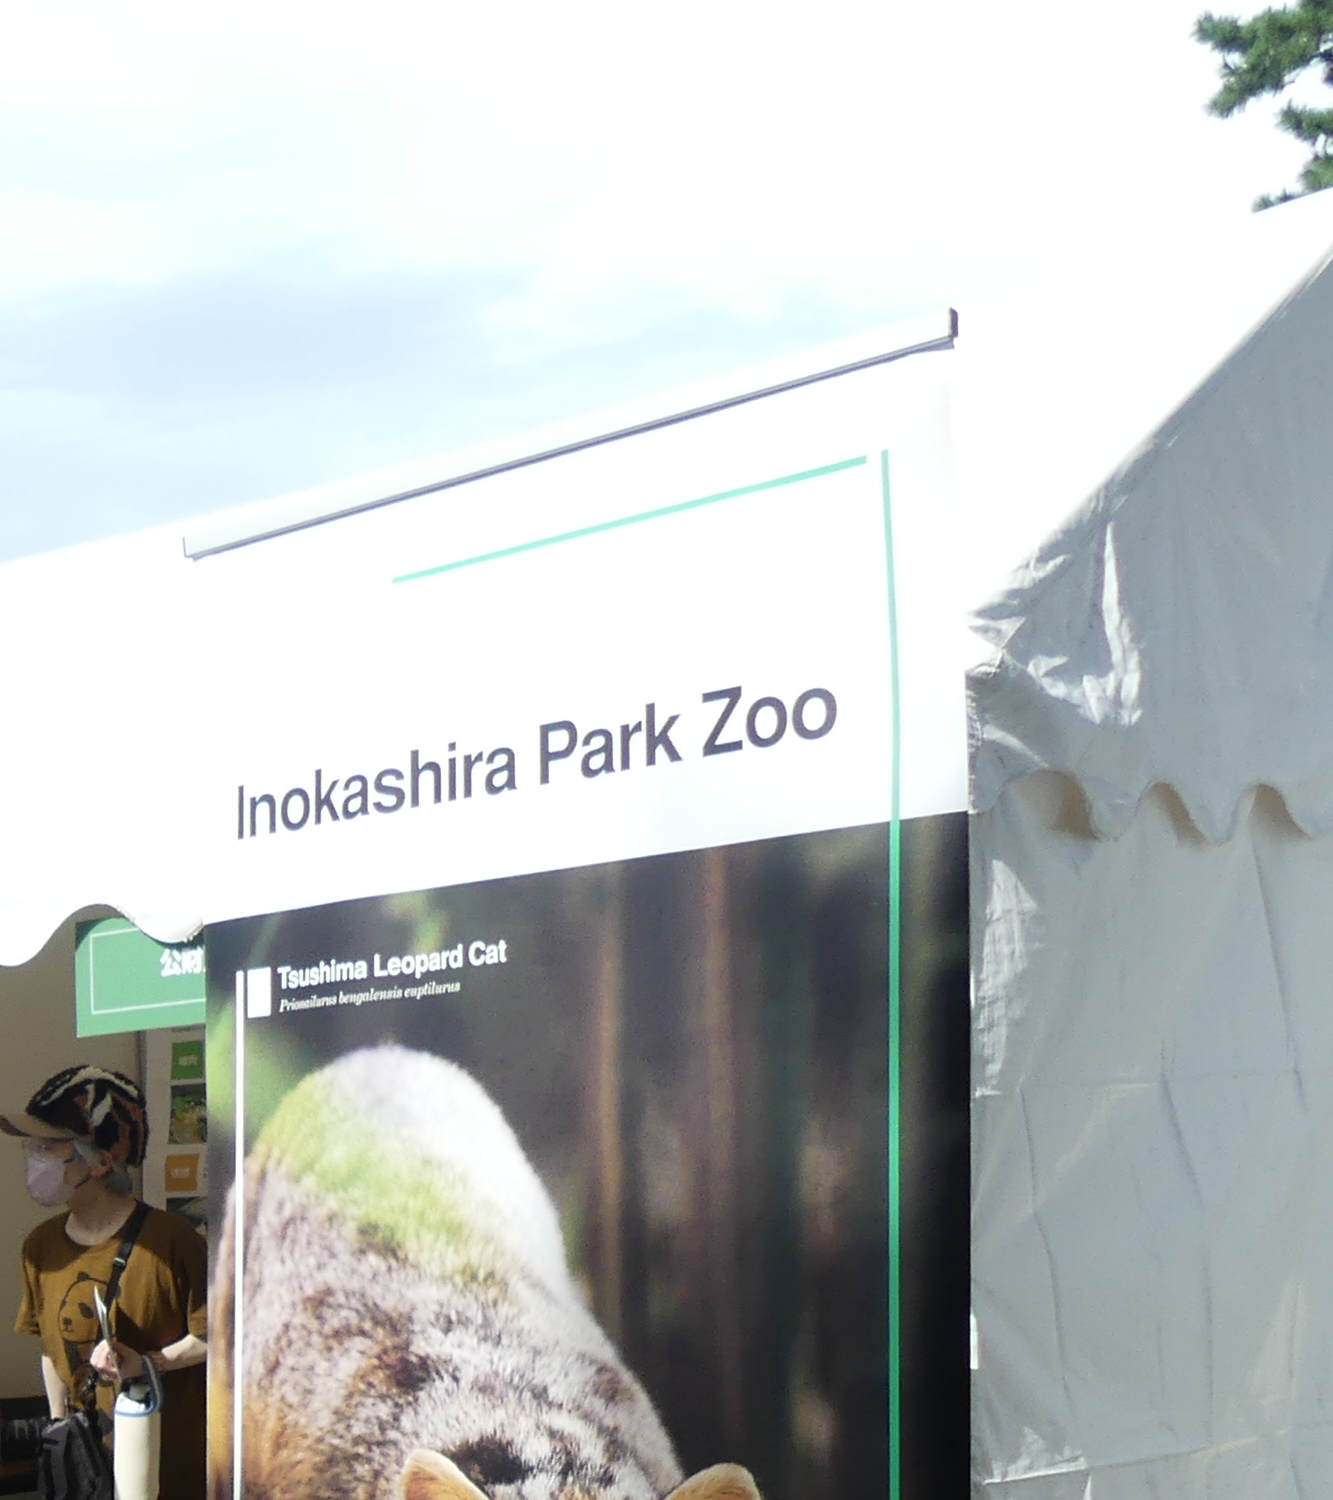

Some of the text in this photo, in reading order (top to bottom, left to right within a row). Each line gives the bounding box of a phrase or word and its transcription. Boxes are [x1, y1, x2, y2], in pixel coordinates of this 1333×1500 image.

[236, 685, 837, 839] Inokashira Park Zoo
[159, 945, 205, 978] 公財
[277, 939, 508, 989] Tsushima Leopard Cat
[339, 985, 402, 1006] bengalensis
